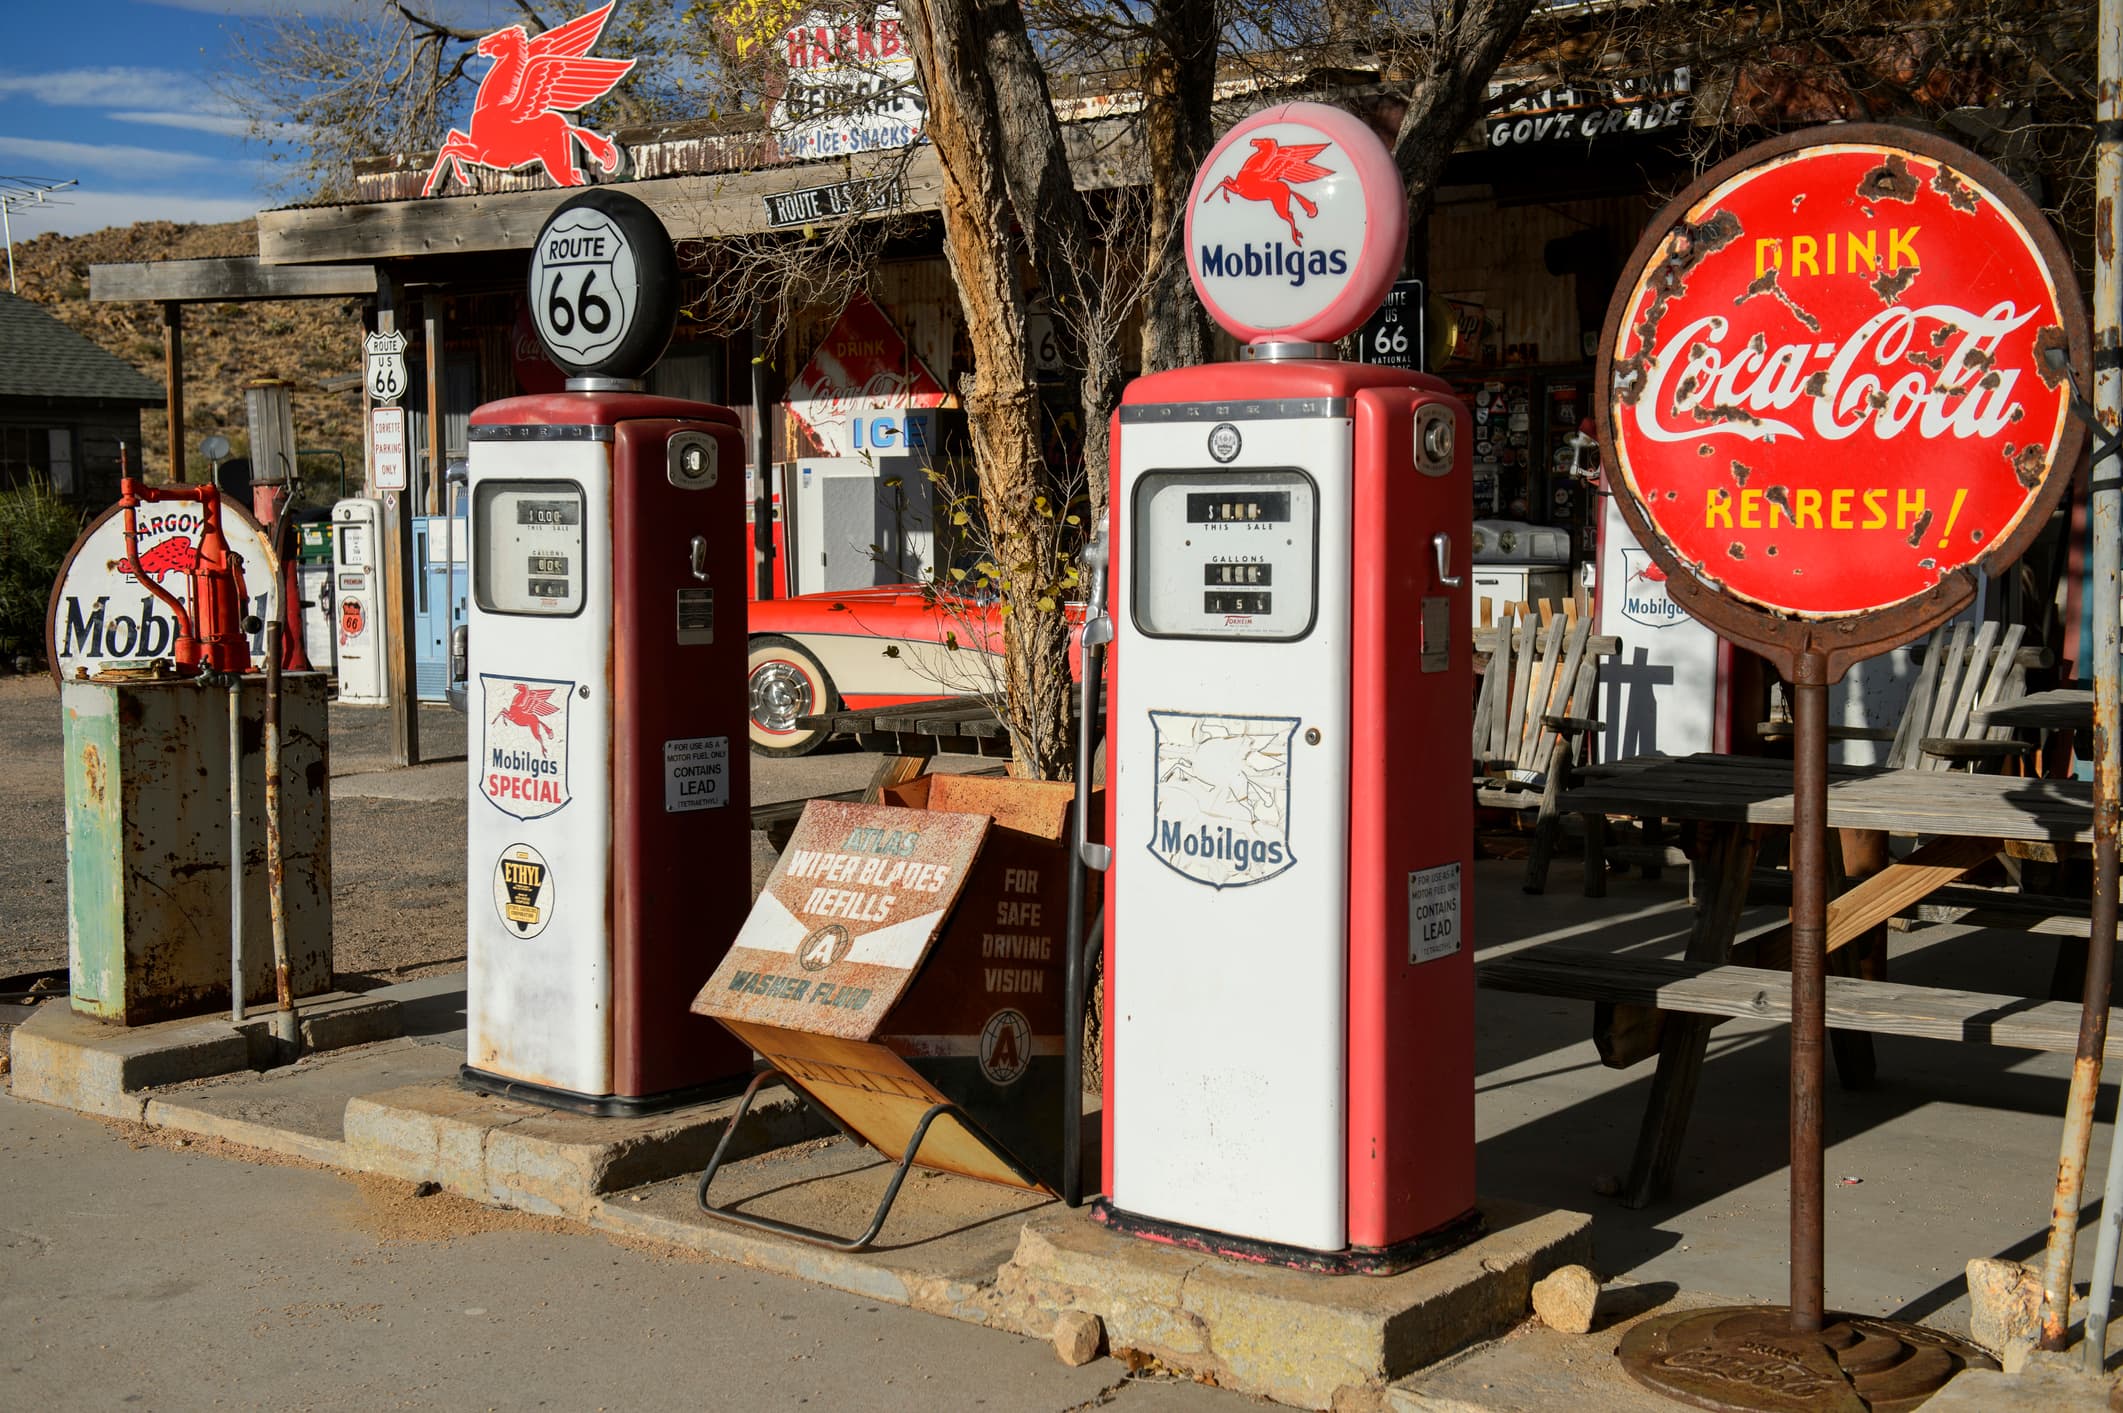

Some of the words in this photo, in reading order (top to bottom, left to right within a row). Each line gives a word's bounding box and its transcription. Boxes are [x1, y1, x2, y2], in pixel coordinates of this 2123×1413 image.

[787, 20, 912, 68] HACKB
[1580, 101, 1686, 137] GRADE
[776, 191, 822, 222] ROUTE
[549, 237, 605, 260] ROUTE
[1755, 226, 1921, 279] DRINK
[1202, 241, 1347, 287] Mobilgas
[549, 269, 611, 336] 66
[1385, 309, 1398, 323] US
[373, 340, 398, 352] ROUTE
[837, 340, 886, 358] DRINK
[1375, 325, 1408, 354] 66
[375, 370, 397, 393] 66
[1636, 300, 2041, 442] Coca-Cola
[375, 421, 401, 434] CORVETTE
[853, 415, 928, 448] ICE
[375, 442, 401, 455] PARKING
[381, 463, 397, 475] ONLY
[1247, 523, 1273, 531] SALE
[1212, 555, 1265, 563] GALLONS
[346, 617, 358, 630] 66
[667, 753, 691, 762] MOTOR
[692, 751, 709, 760] FUEL
[711, 751, 726, 759] ONLY
[674, 743, 688, 751] FOR
[690, 742, 702, 750] USE
[705, 741, 713, 749] AS
[715, 740, 720, 748] A
[492, 747, 558, 778] Mobilgas
[673, 763, 722, 778] CONTAINS
[489, 773, 562, 804] SPECIAL
[680, 779, 716, 796] LEAD
[842, 826, 920, 857] ATLAS
[1161, 819, 1284, 872] Mobilgas
[504, 862, 542, 887] ETHYL
[787, 850, 861, 884] WIPER
[861, 858, 953, 893] BLADES
[1004, 868, 1039, 894] FOR
[1418, 876, 1429, 885] FOR
[1431, 873, 1442, 883] USE
[802, 887, 896, 922] REFILLS
[1412, 887, 1433, 899] MOTOR
[997, 901, 1041, 927] SAFE
[1416, 897, 1457, 920] CONTAINS
[1423, 918, 1452, 942] LEAD
[806, 934, 838, 964] A
[982, 933, 1051, 960] DRIVING
[728, 970, 812, 1001] WASHER
[809, 981, 873, 1011] FLUID
[984, 968, 1044, 993] VISION
[988, 1023, 1019, 1067] A
